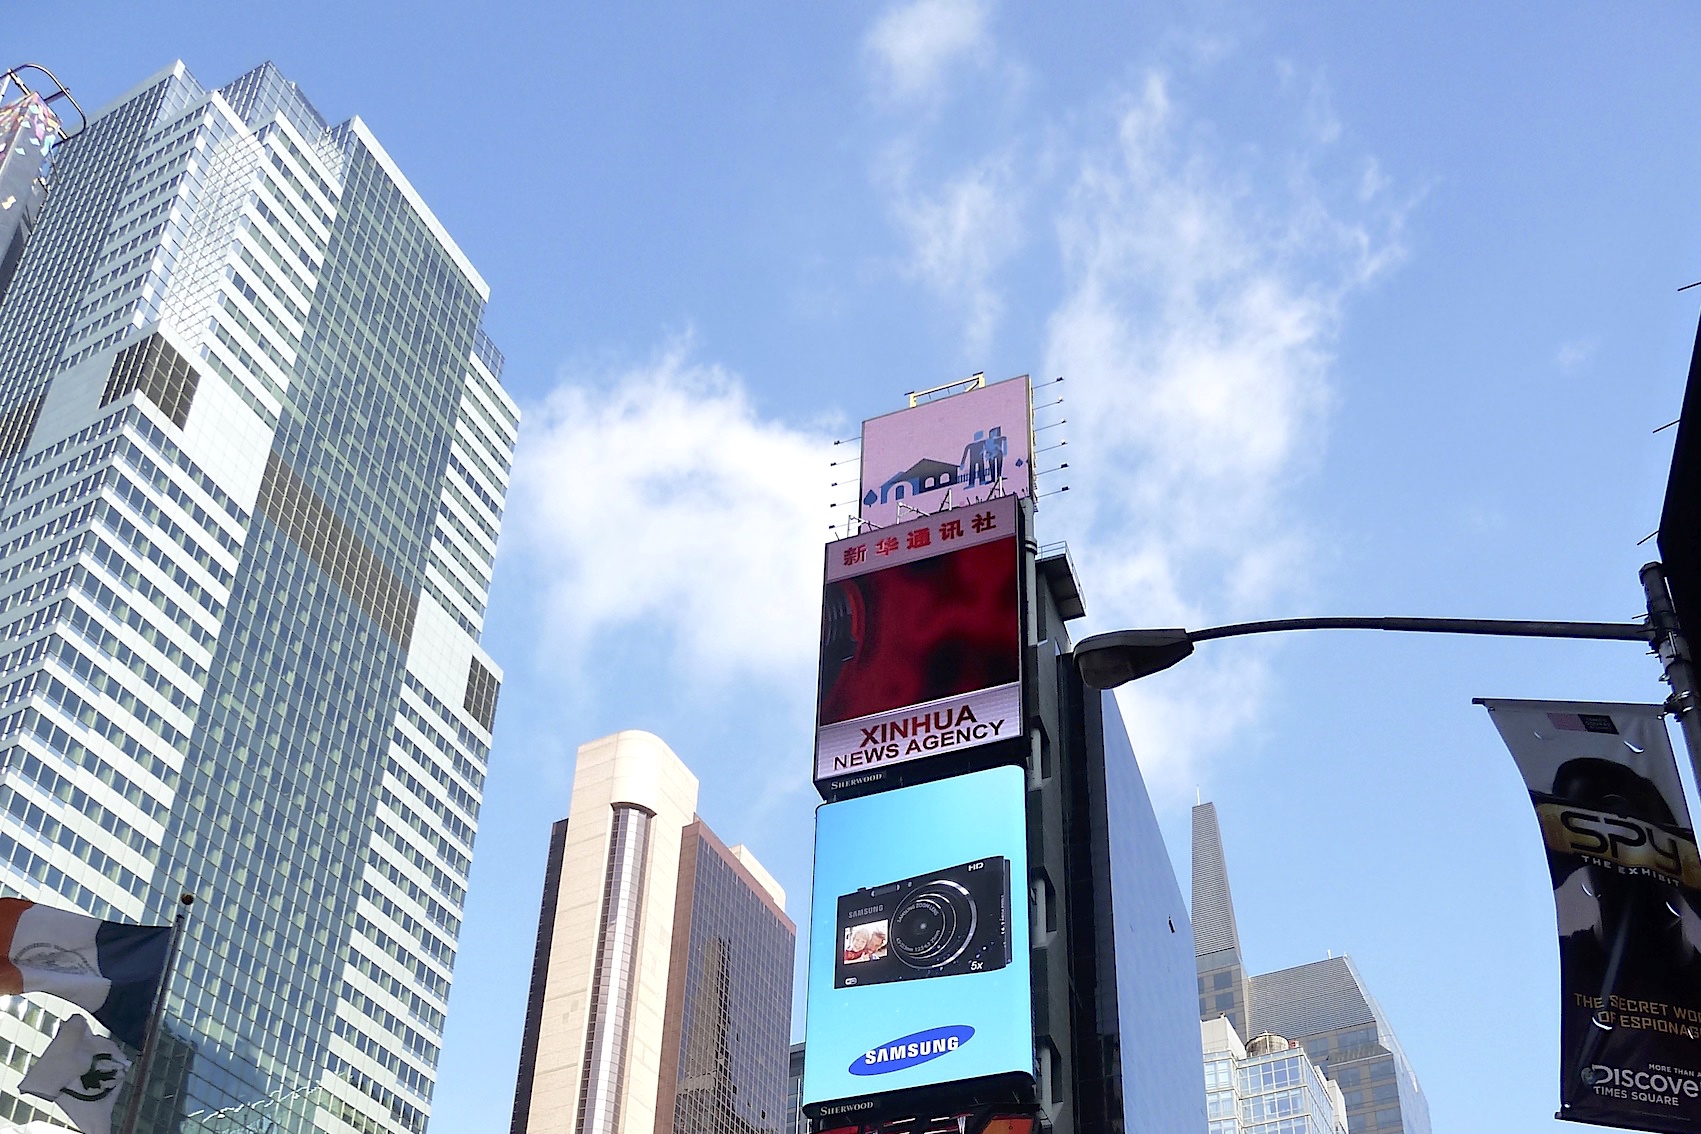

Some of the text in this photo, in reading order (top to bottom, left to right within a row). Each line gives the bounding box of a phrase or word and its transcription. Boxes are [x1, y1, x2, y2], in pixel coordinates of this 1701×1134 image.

[843, 511, 997, 566] 新华通讯社
[860, 705, 977, 747] XINHUA
[834, 719, 1005, 771] NEWS AGENCY
[830, 773, 883, 791] SHERWOOD
[1560, 810, 1684, 877] SPY
[1581, 855, 1681, 888] THE EXHIBIT
[848, 903, 884, 919] SAMSUNG
[970, 960, 984, 970] 5x
[1574, 992, 1604, 1008] THE
[1609, 995, 1668, 1016] SECRET
[1598, 1011, 1701, 1040] OF ESPIONAG
[864, 1036, 959, 1065] SAMSUNG
[1648, 1063, 1670, 1073] MORE
[1673, 1066, 1695, 1077] THAN
[819, 1101, 874, 1116] SHERWOOD
[1593, 1086, 1680, 1107] TIMES SQUARE
